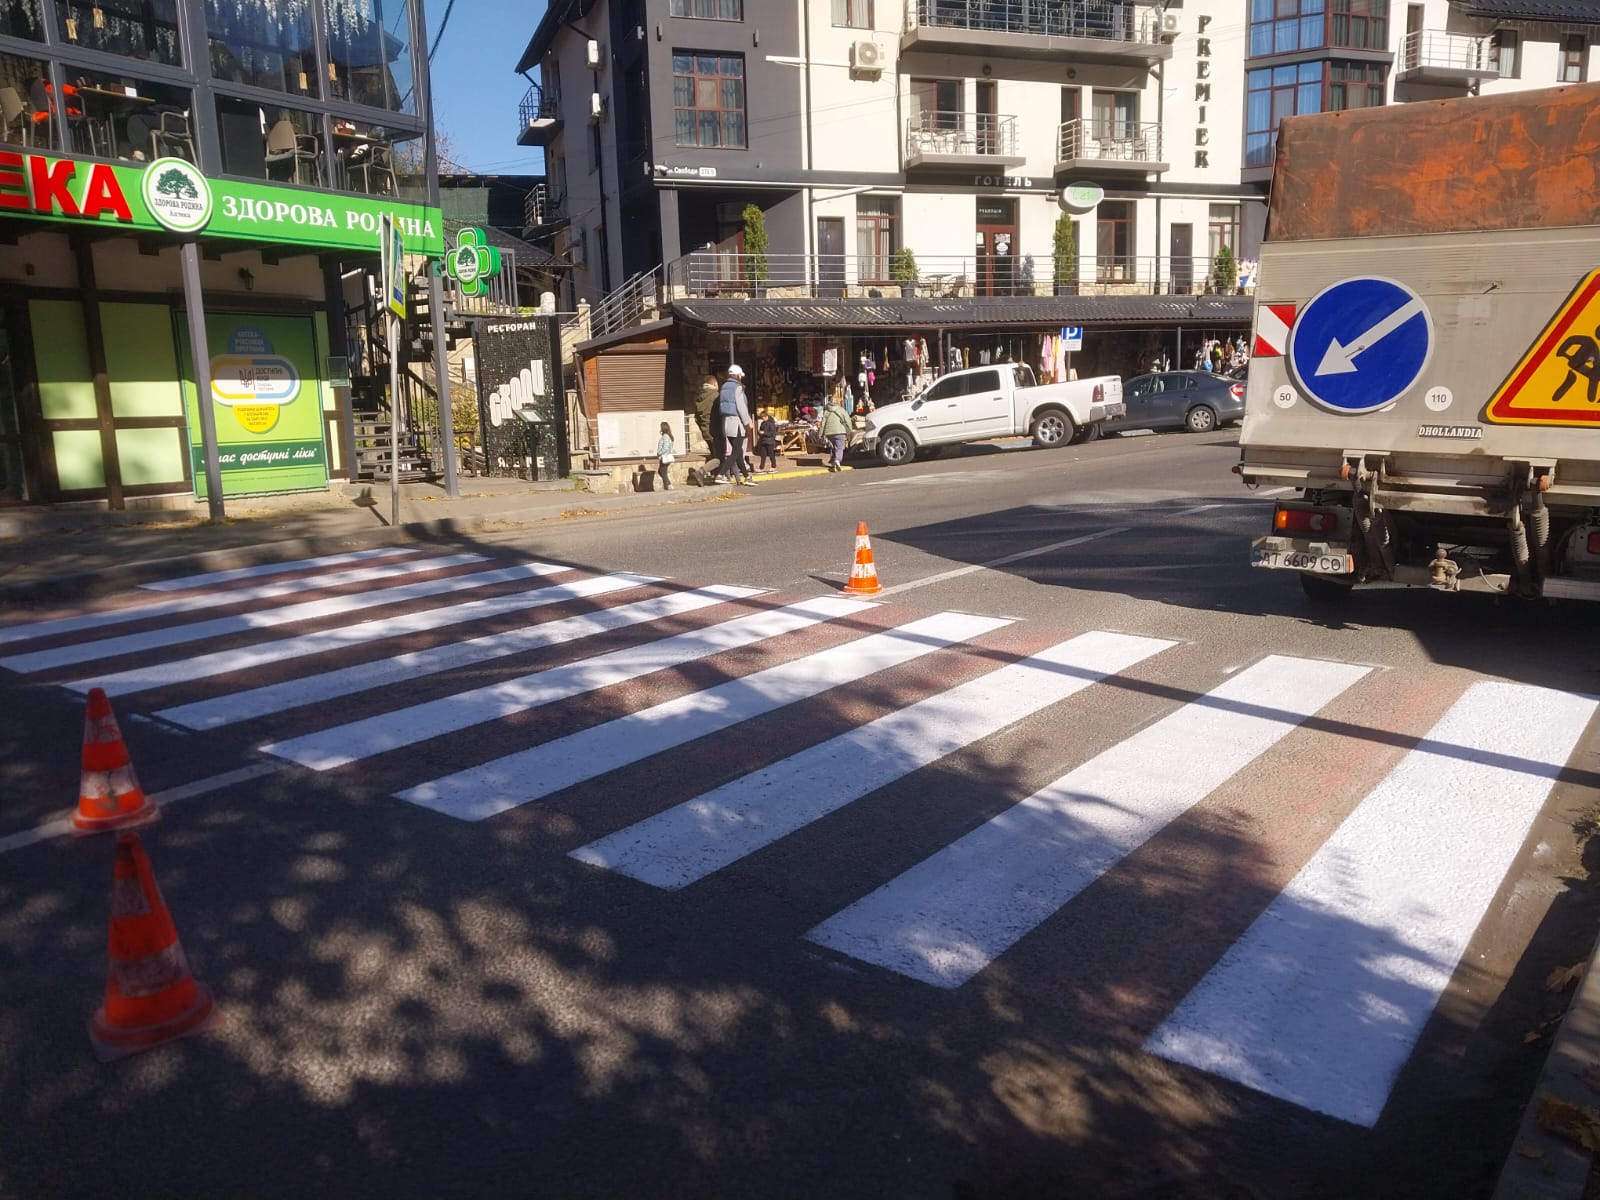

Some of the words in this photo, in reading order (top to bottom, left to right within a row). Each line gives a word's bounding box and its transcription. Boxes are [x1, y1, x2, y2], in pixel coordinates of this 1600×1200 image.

[1194, 15, 1212, 168] PREMIER
[974, 176, 1032, 187] ГОТЕЛЬ
[155, 198, 180, 208] ЗДОРОВА
[180, 202, 203, 211] РОДИНА
[222, 196, 338, 228] ЗДОРОВА
[487, 322, 536, 333] РЕСТОРАН
[1066, 327, 1078, 340] P
[1279, 392, 1291, 401] 50
[1431, 394, 1447, 403] 110
[1418, 426, 1482, 439] DHOLLANDIA
[239, 447, 289, 465] доступні
[497, 456, 545, 468] ЯРЕМЕ
[1263, 552, 1281, 566] AT
[1284, 553, 1317, 569] 6609
[1320, 557, 1341, 571] CO
